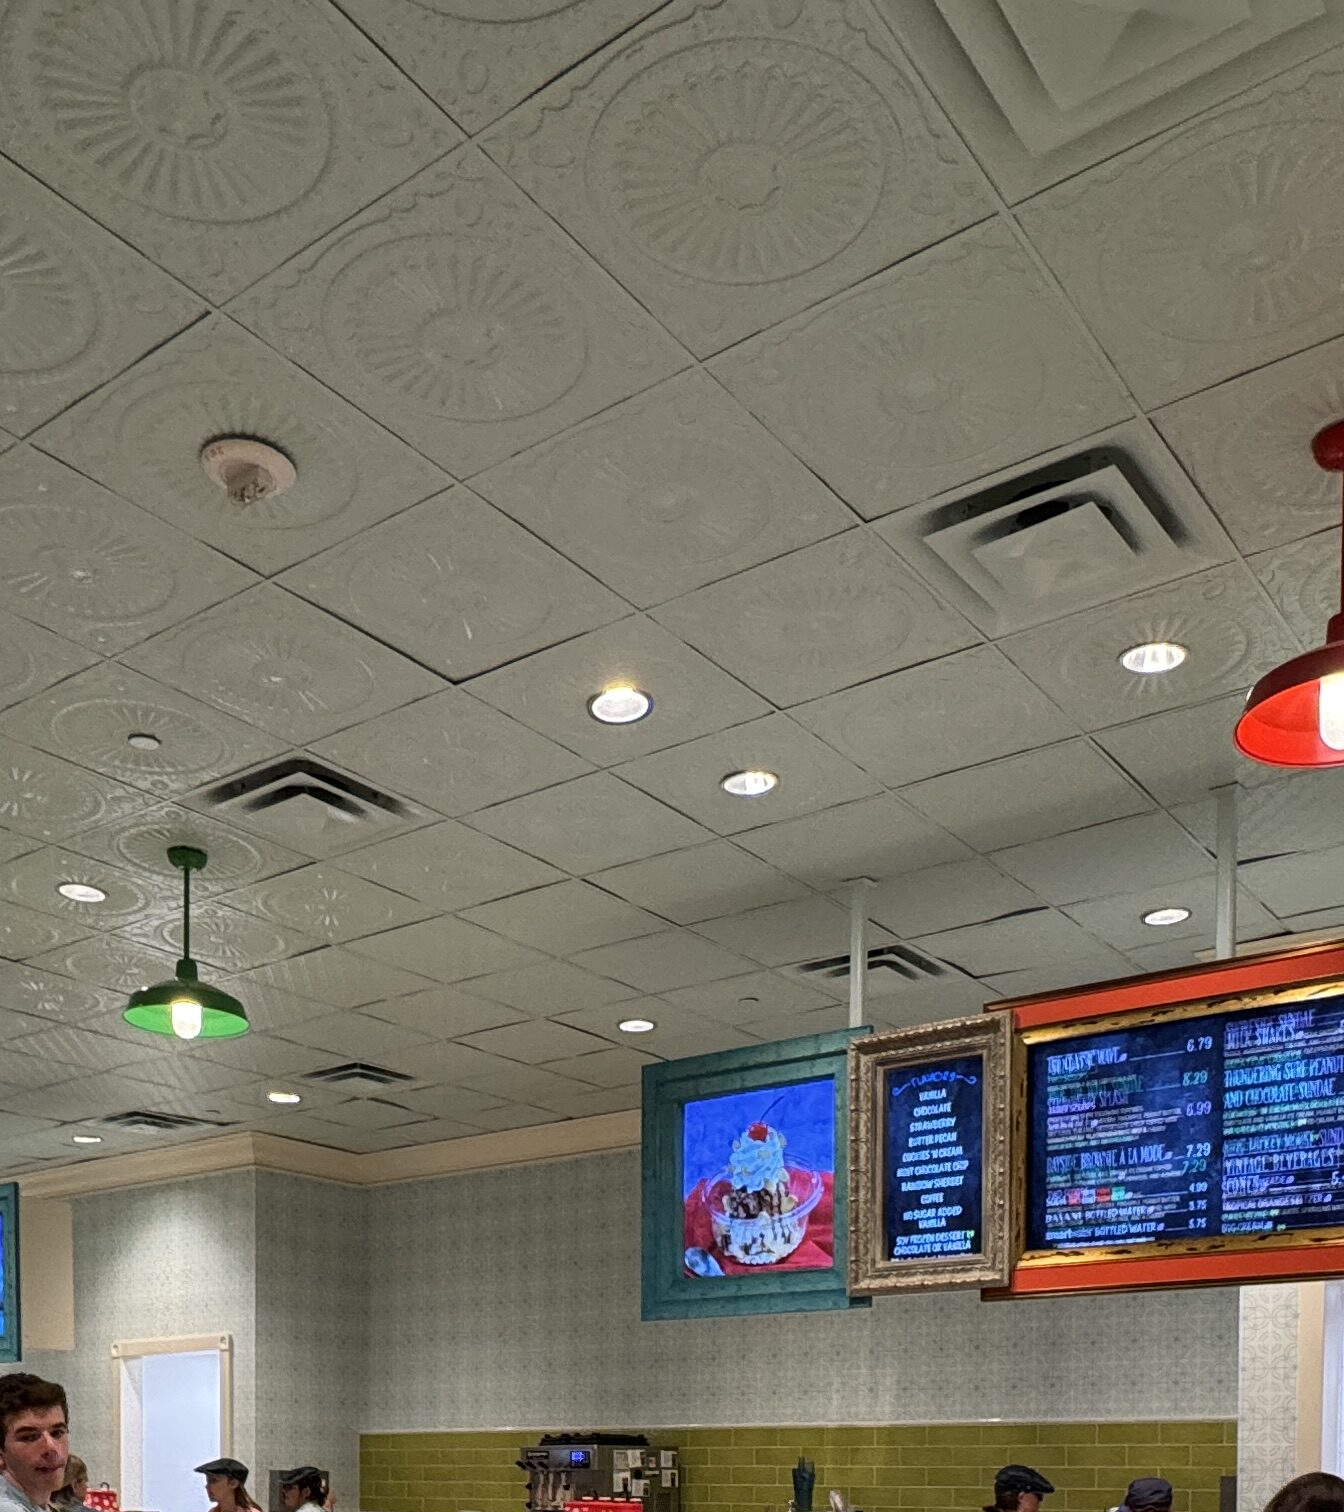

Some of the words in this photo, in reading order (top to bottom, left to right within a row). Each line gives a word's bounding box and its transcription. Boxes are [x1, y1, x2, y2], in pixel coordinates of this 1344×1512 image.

[1186, 1036, 1213, 1052] 6.79
[1309, 1055, 1344, 1077] PEANUT
[919, 1088, 947, 1101] VANILLA
[1224, 1090, 1243, 1109] AND
[913, 1102, 952, 1117] CHOCOLATE
[910, 1116, 956, 1132] STRAWBERRY
[908, 1134, 934, 1147] BUTTER
[935, 1131, 957, 1143] PECAN
[902, 1150, 930, 1163] COOKIES
[939, 1145, 963, 1158] CREAM
[1127, 1147, 1138, 1163] LA
[1140, 1144, 1165, 1162] MODE
[1186, 1142, 1211, 1158] 7.29
[1272, 1148, 1335, 1173] BEVERAGES
[897, 1167, 914, 1177] MINT
[915, 1162, 952, 1175] CHOCOLATE
[934, 1175, 964, 1188] SHERBET
[920, 1192, 944, 1204] COFFEE
[913, 1208, 936, 1220] SUGAR
[937, 1205, 963, 1217] ADDED
[918, 1217, 946, 1229] VANILLA
[1094, 1224, 1128, 1236] BOTTLED
[1129, 1222, 1156, 1233] WATER
[896, 1236, 909, 1245] SOY
[910, 1233, 935, 1244] FROZEN
[936, 1230, 965, 1242] DESSERT
[893, 1244, 931, 1256] CHOCOLATE
[932, 1242, 942, 1252] OR
[943, 1240, 971, 1252] VANILLA
